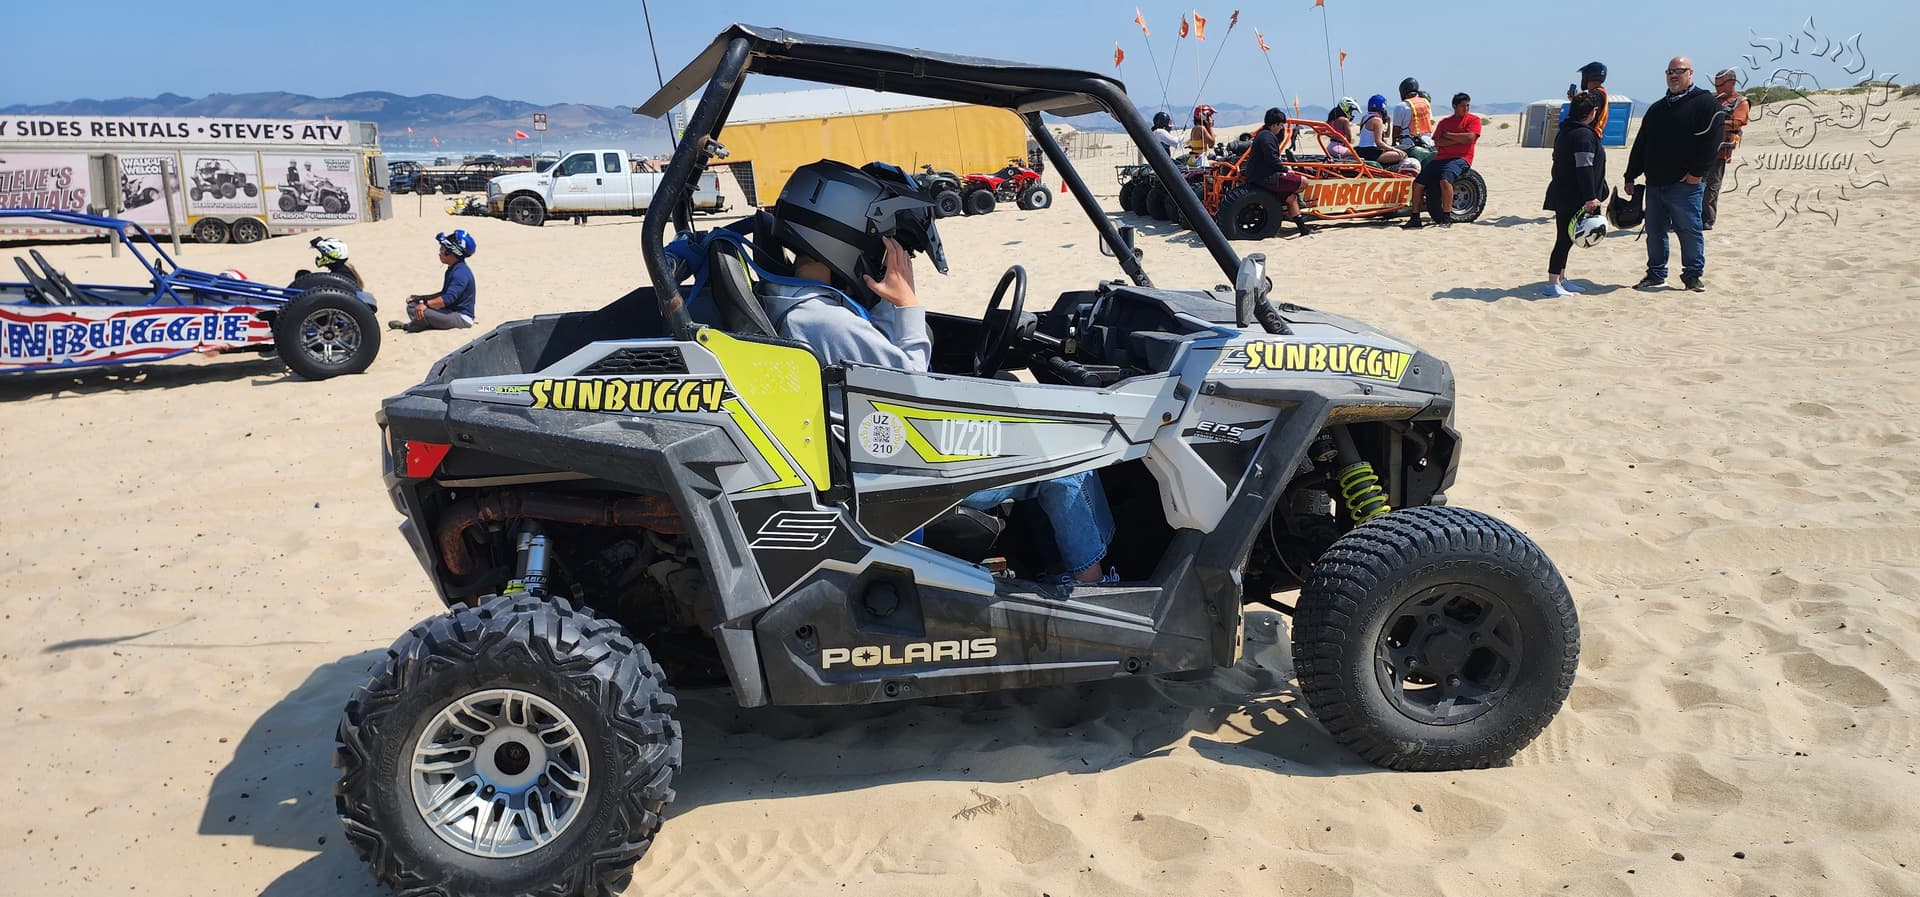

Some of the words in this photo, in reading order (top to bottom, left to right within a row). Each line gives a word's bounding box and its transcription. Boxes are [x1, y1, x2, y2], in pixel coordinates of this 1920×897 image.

[16, 120, 82, 137] SIDES
[90, 121, 190, 138] RENTALS
[210, 123, 294, 140] STEVE'S
[302, 125, 343, 141] ATV
[0, 166, 73, 190] TEVE'S
[125, 166, 174, 175] WELCOE
[1303, 180, 1412, 207] UNBUGGIE
[0, 315, 249, 358] NBUGGIE
[1246, 340, 1401, 379] SUNBUGGY
[530, 378, 727, 412] SUNBUGGY
[873, 415, 889, 425] UZ
[1197, 421, 1245, 437] EPS
[873, 444, 893, 454] 210
[940, 418, 1002, 457] UZ210
[822, 637, 997, 669] POLARIS
